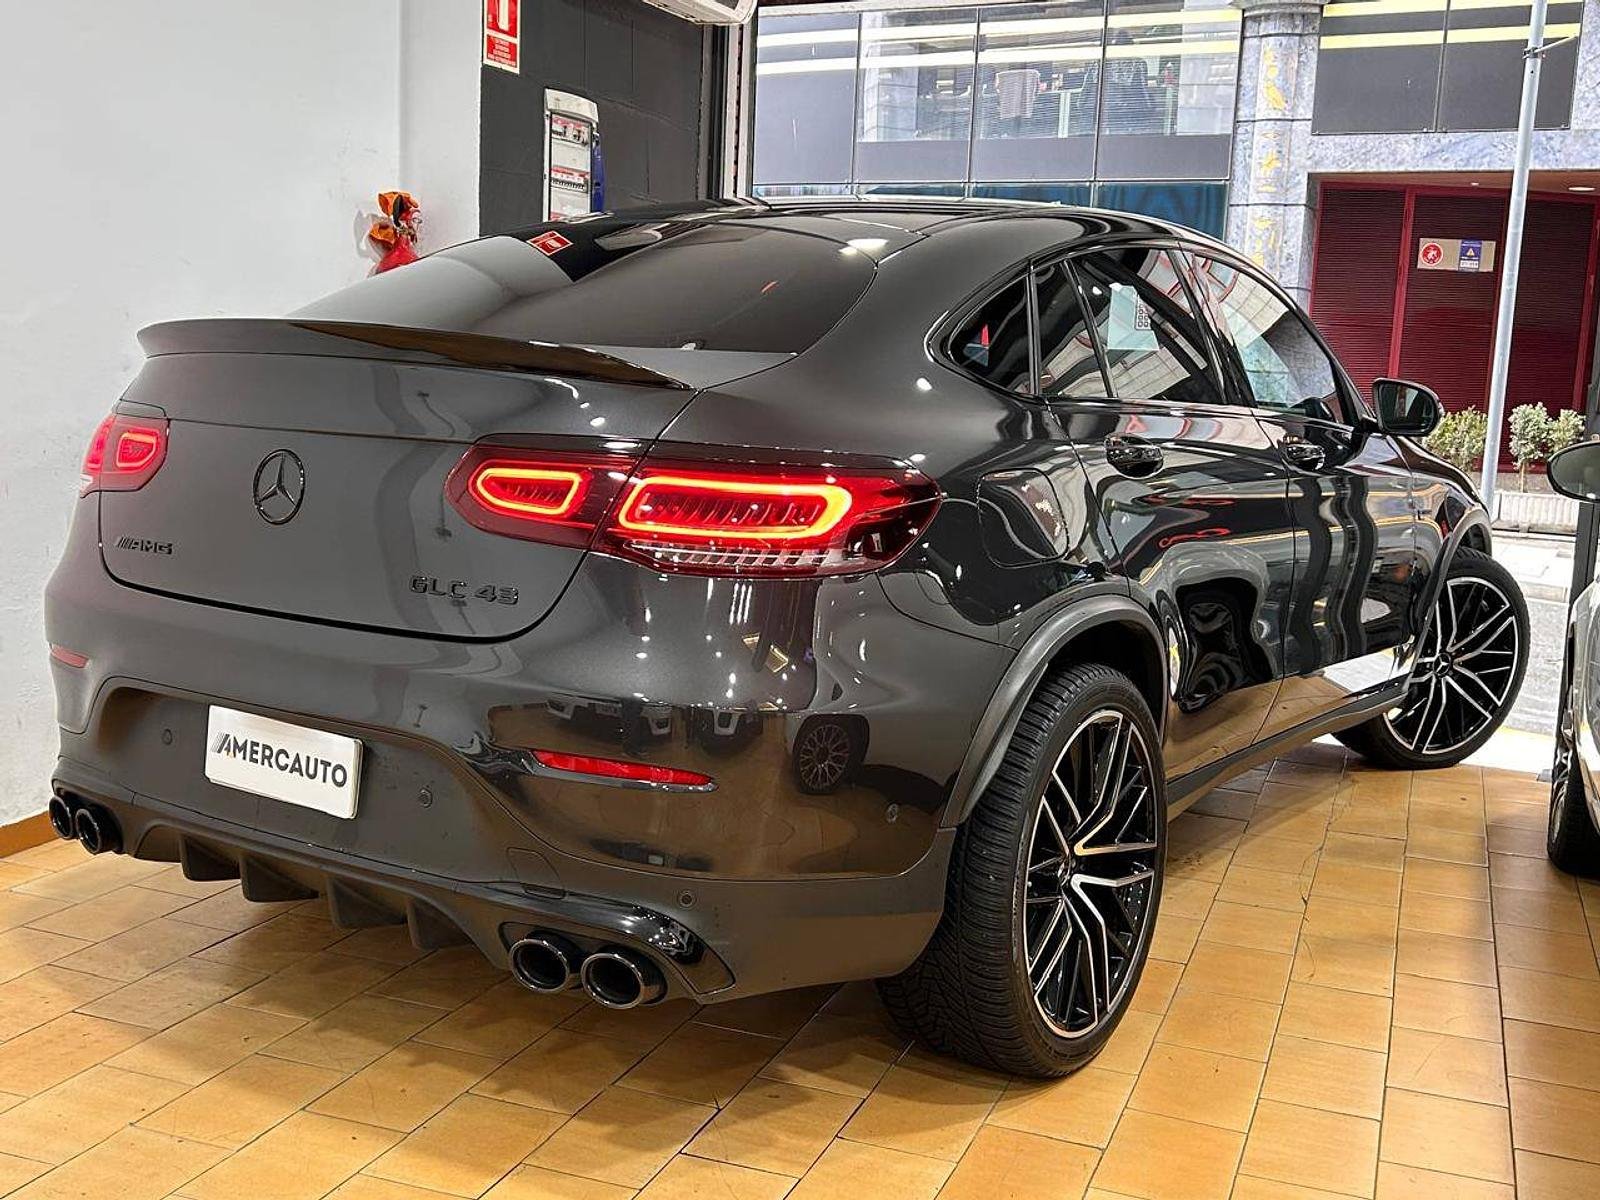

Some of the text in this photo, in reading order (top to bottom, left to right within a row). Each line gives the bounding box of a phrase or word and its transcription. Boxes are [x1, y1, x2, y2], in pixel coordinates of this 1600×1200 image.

[122, 537, 172, 554] AMG
[410, 576, 518, 605] GLC 43
